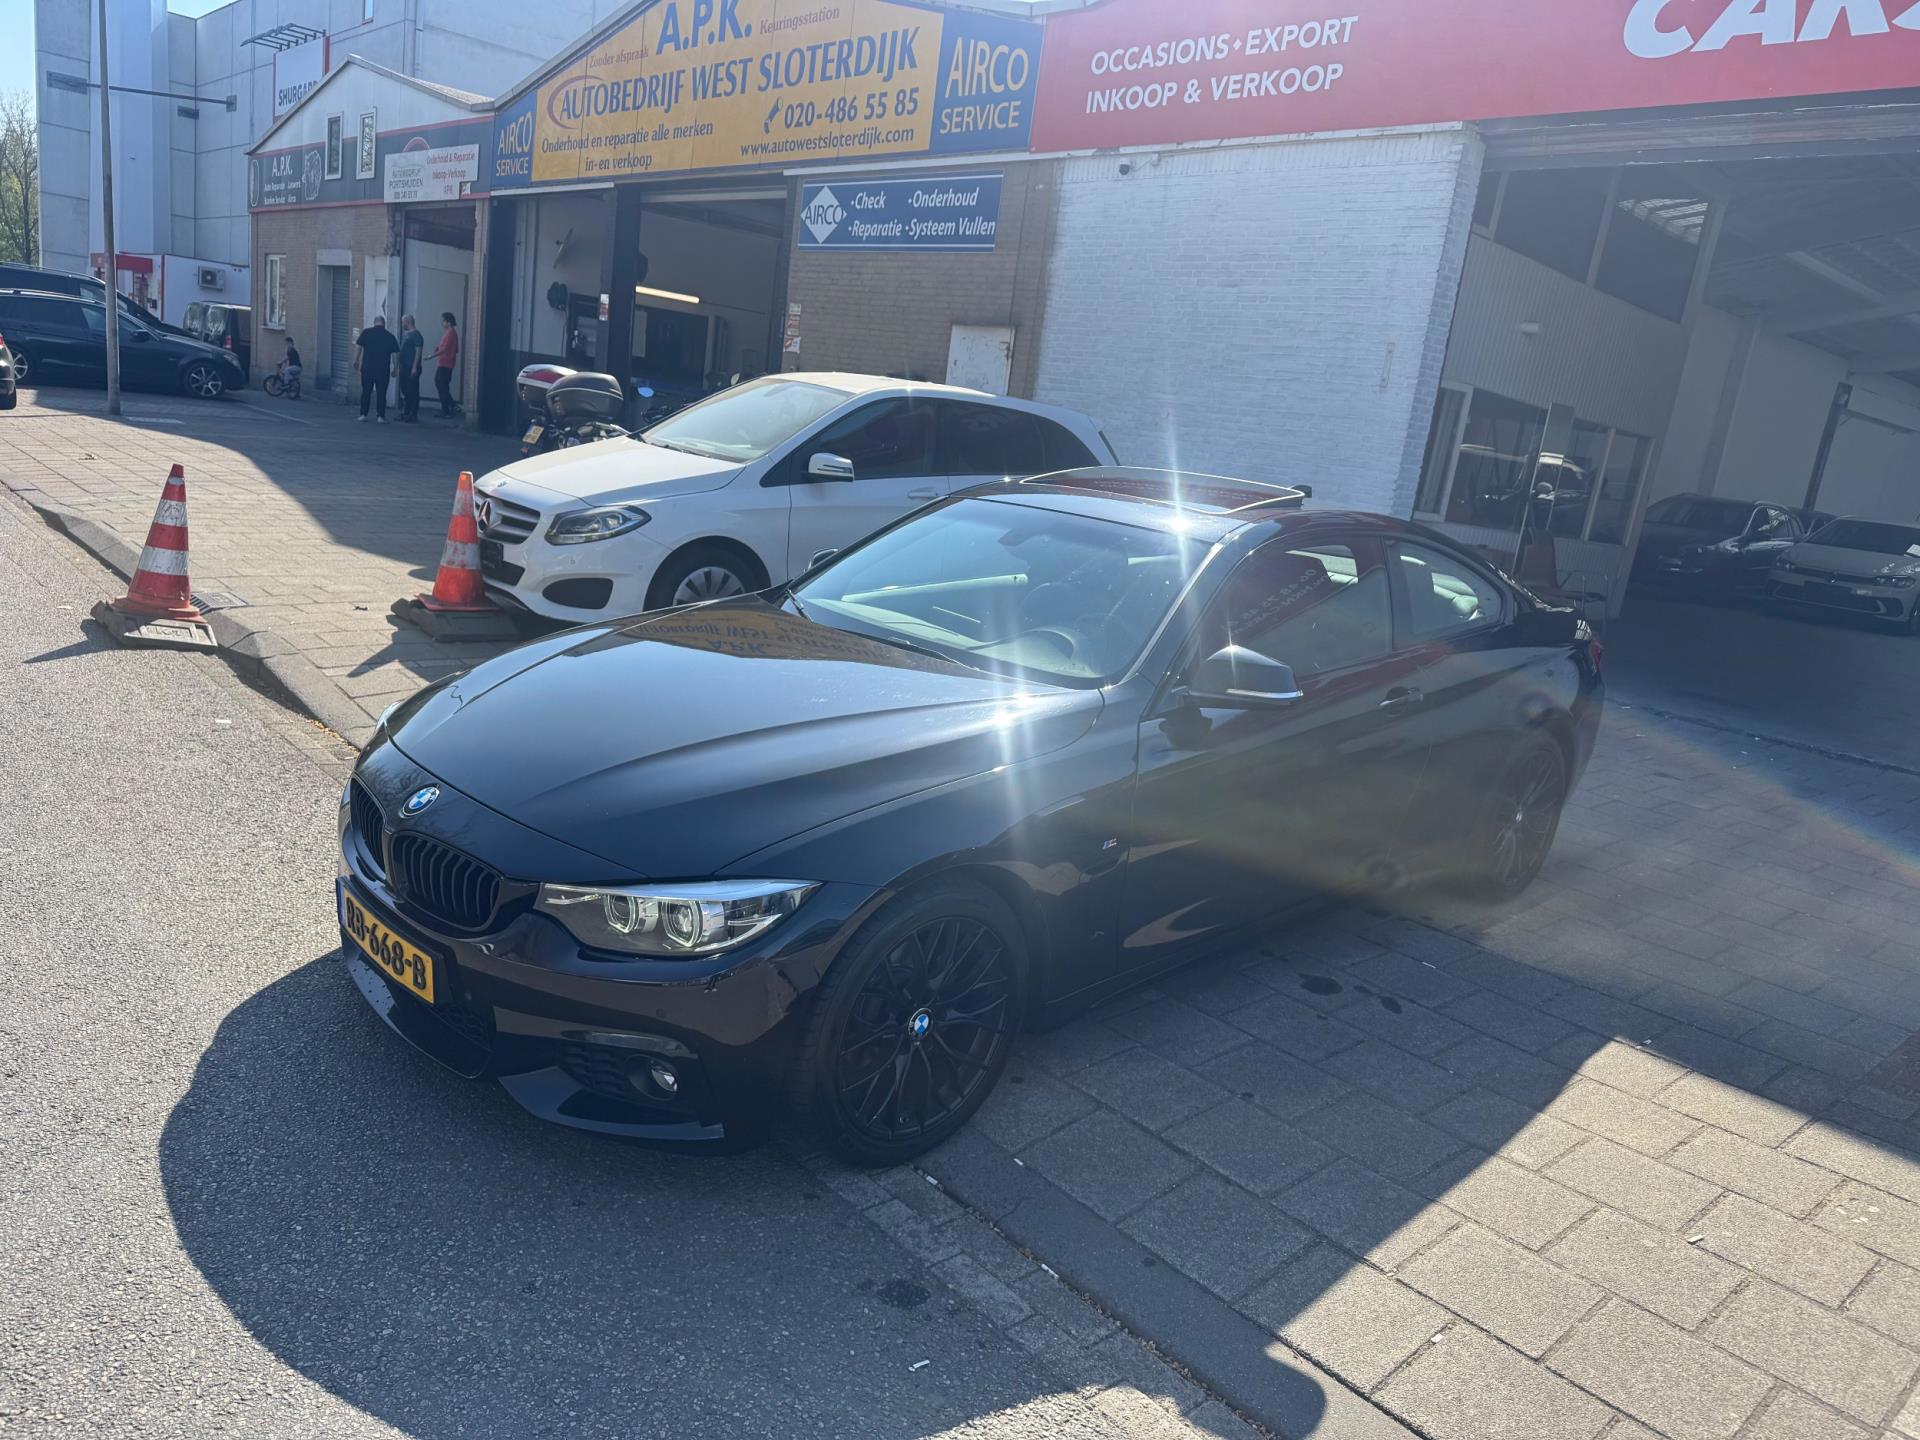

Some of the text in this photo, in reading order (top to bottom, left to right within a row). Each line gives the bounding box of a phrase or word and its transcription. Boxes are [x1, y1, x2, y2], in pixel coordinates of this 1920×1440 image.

[655, 0, 753, 55] A.P.K.
[759, 6, 840, 35] Keuringsstation
[1623, 0, 1920, 59] CA
[589, 45, 649, 68] Zonder afspraak
[1090, 15, 1359, 75] OCCASIONS EXPORT
[559, 26, 920, 121] AUTOBEDRIJF WEST SLOTERDIJK
[945, 36, 1029, 98] AIRCO
[1085, 63, 1344, 114] INKOOP & VERKOOP
[784, 87, 919, 129] 020-486 55 85
[939, 101, 1021, 135] SERVICE
[497, 111, 533, 156] AIRCO
[542, 119, 714, 154] Onderhoud en reparatie alle merken
[740, 126, 915, 157] www.autowestsloterdijk.com
[272, 154, 293, 177] A.P.K.
[495, 157, 529, 177] SERVICE
[612, 151, 653, 171] verkoop
[804, 204, 843, 226] AIRCO
[855, 187, 980, 209] Check Onderhoud
[851, 216, 996, 240] Reparatie Systeem Vullen
[346, 896, 427, 991] RB-668-B
